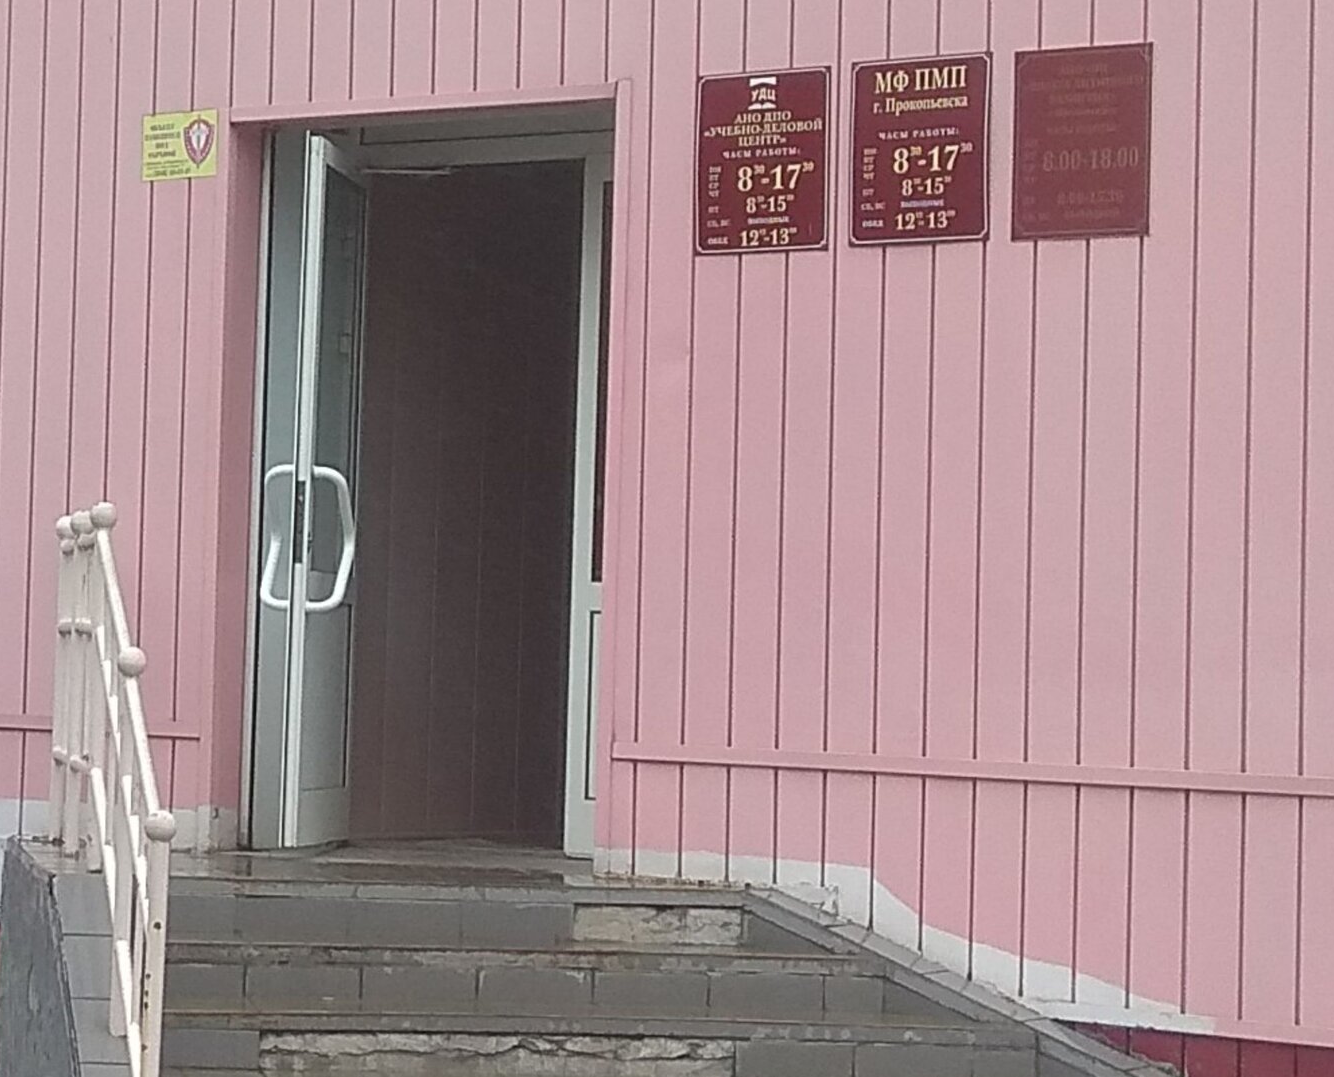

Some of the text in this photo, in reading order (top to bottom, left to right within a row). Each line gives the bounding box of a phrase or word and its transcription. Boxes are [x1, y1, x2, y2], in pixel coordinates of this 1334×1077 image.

[875, 65, 968, 94] МФ ПМП
[751, 88, 776, 101] УДЦ
[873, 95, 969, 116] г. Прокопьевска
[734, 111, 791, 124] АНО ДПО
[704, 118, 823, 137] «УЧЕБНО-ДЕЛОВОЙ
[878, 127, 959, 141] ЧАСЫ РАБОТЫ:
[738, 135, 786, 147] ЦЕНТР»
[723, 151, 752, 159] ЧАСЫ
